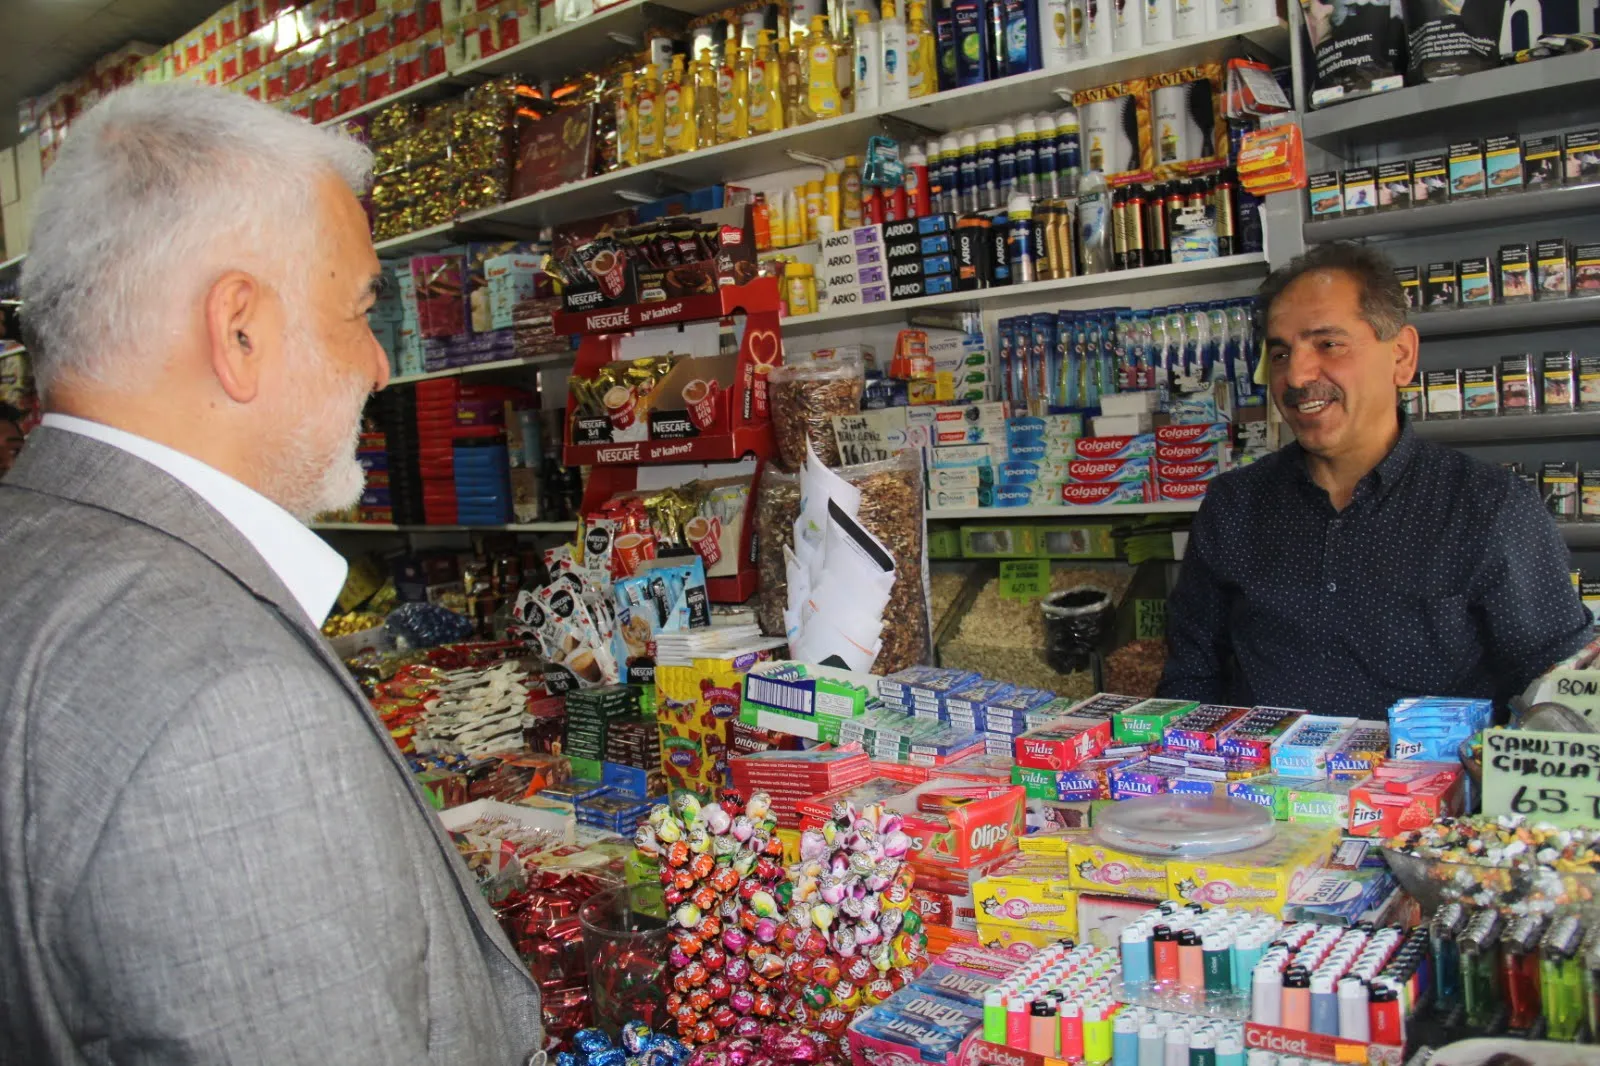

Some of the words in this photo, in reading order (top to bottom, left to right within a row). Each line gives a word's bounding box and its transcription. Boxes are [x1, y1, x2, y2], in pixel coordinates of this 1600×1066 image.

[1147, 68, 1202, 90] PANTENE
[1074, 84, 1126, 104] PANTENE
[885, 223, 914, 238] ARKO
[825, 236, 848, 248] ARKO
[888, 243, 916, 257] ARKO
[960, 236, 970, 266] ARKO
[996, 236, 1005, 266] ARKO
[827, 254, 851, 268] ARKO
[890, 262, 918, 277] ARKO
[829, 274, 853, 286] ARKO
[892, 282, 920, 296] ARKO
[831, 293, 857, 306] ARKO
[587, 308, 630, 330] NESCAFÉ
[652, 304, 682, 318] kahve?
[1158, 424, 1202, 440] Colgate
[596, 444, 640, 463] NESCAFÉ
[662, 442, 694, 456] kahve?
[1077, 440, 1124, 454] Colgate
[1159, 444, 1202, 459] Colgate
[1070, 460, 1117, 475] Colgate
[1160, 462, 1206, 478] Colgate
[1064, 482, 1110, 498] Colgate
[1162, 482, 1208, 495] Colgate
[630, 667, 654, 677] NESCAF
[1123, 719, 1152, 732] yıldız
[1026, 744, 1054, 757] yıldız
[1167, 737, 1200, 750] FALIM
[1394, 742, 1422, 757] First
[1276, 756, 1310, 768] FALIM
[1331, 760, 1368, 771] FALIM
[1021, 772, 1049, 786] yıldız
[1060, 780, 1093, 792] FALIM
[1118, 781, 1152, 794] FALIM
[1294, 802, 1332, 816] FALIM
[1354, 808, 1384, 820] First
[971, 822, 1008, 851] Olips
[1246, 1028, 1307, 1054] Cricket
[978, 1046, 1025, 1066] Cricket
